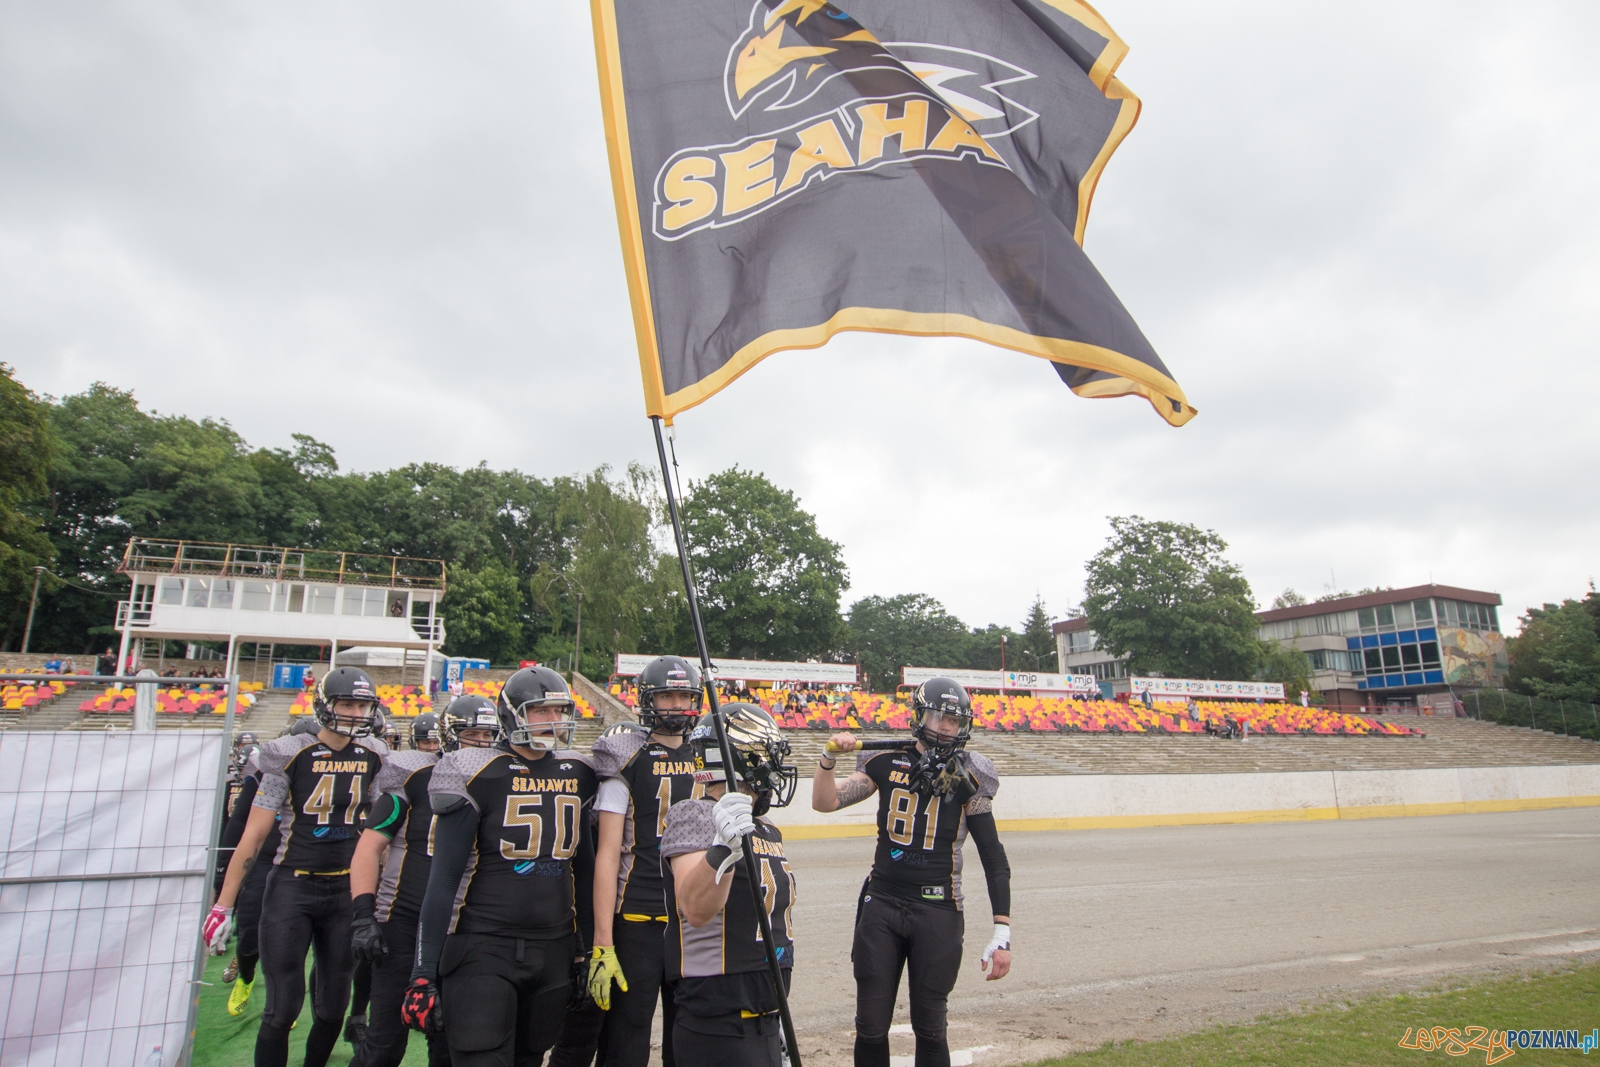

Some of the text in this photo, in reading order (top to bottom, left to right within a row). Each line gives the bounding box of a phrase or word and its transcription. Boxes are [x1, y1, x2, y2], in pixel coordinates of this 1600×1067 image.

[1018, 674, 1037, 684] mjp
[1074, 676, 1093, 686] mjp
[311, 760, 368, 773] SEAHAWKS
[511, 776, 579, 793] SEAHAWKS
[303, 773, 362, 825] 41
[499, 794, 582, 860] 50
[886, 787, 941, 850] 81
